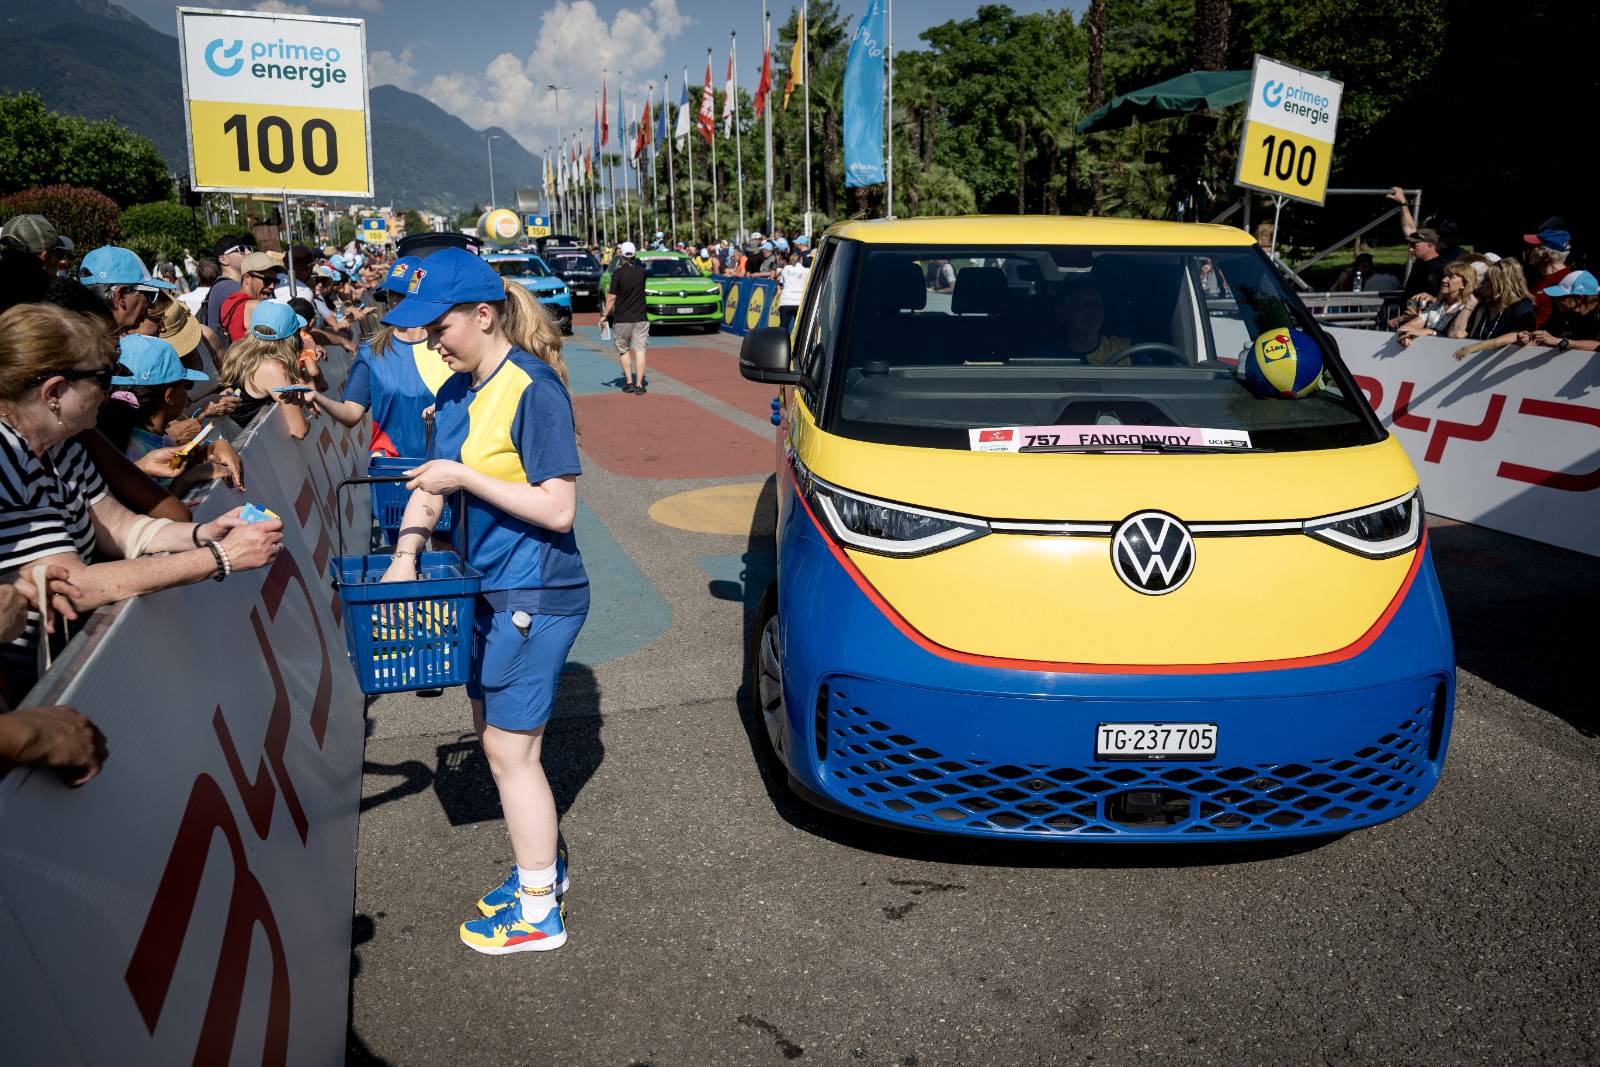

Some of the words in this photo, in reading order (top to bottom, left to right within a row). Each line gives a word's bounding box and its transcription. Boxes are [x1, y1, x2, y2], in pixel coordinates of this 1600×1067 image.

[251, 38, 341, 63] primeo
[251, 63, 347, 88] energie
[1285, 86, 1329, 108] primeo
[1284, 101, 1329, 125] energie
[223, 114, 339, 176] 100
[1262, 134, 1317, 187] 100
[369, 231, 382, 240] 150
[532, 227, 547, 236] 150
[1025, 435, 1061, 446] 757
[1079, 434, 1192, 446] FANCONVOY
